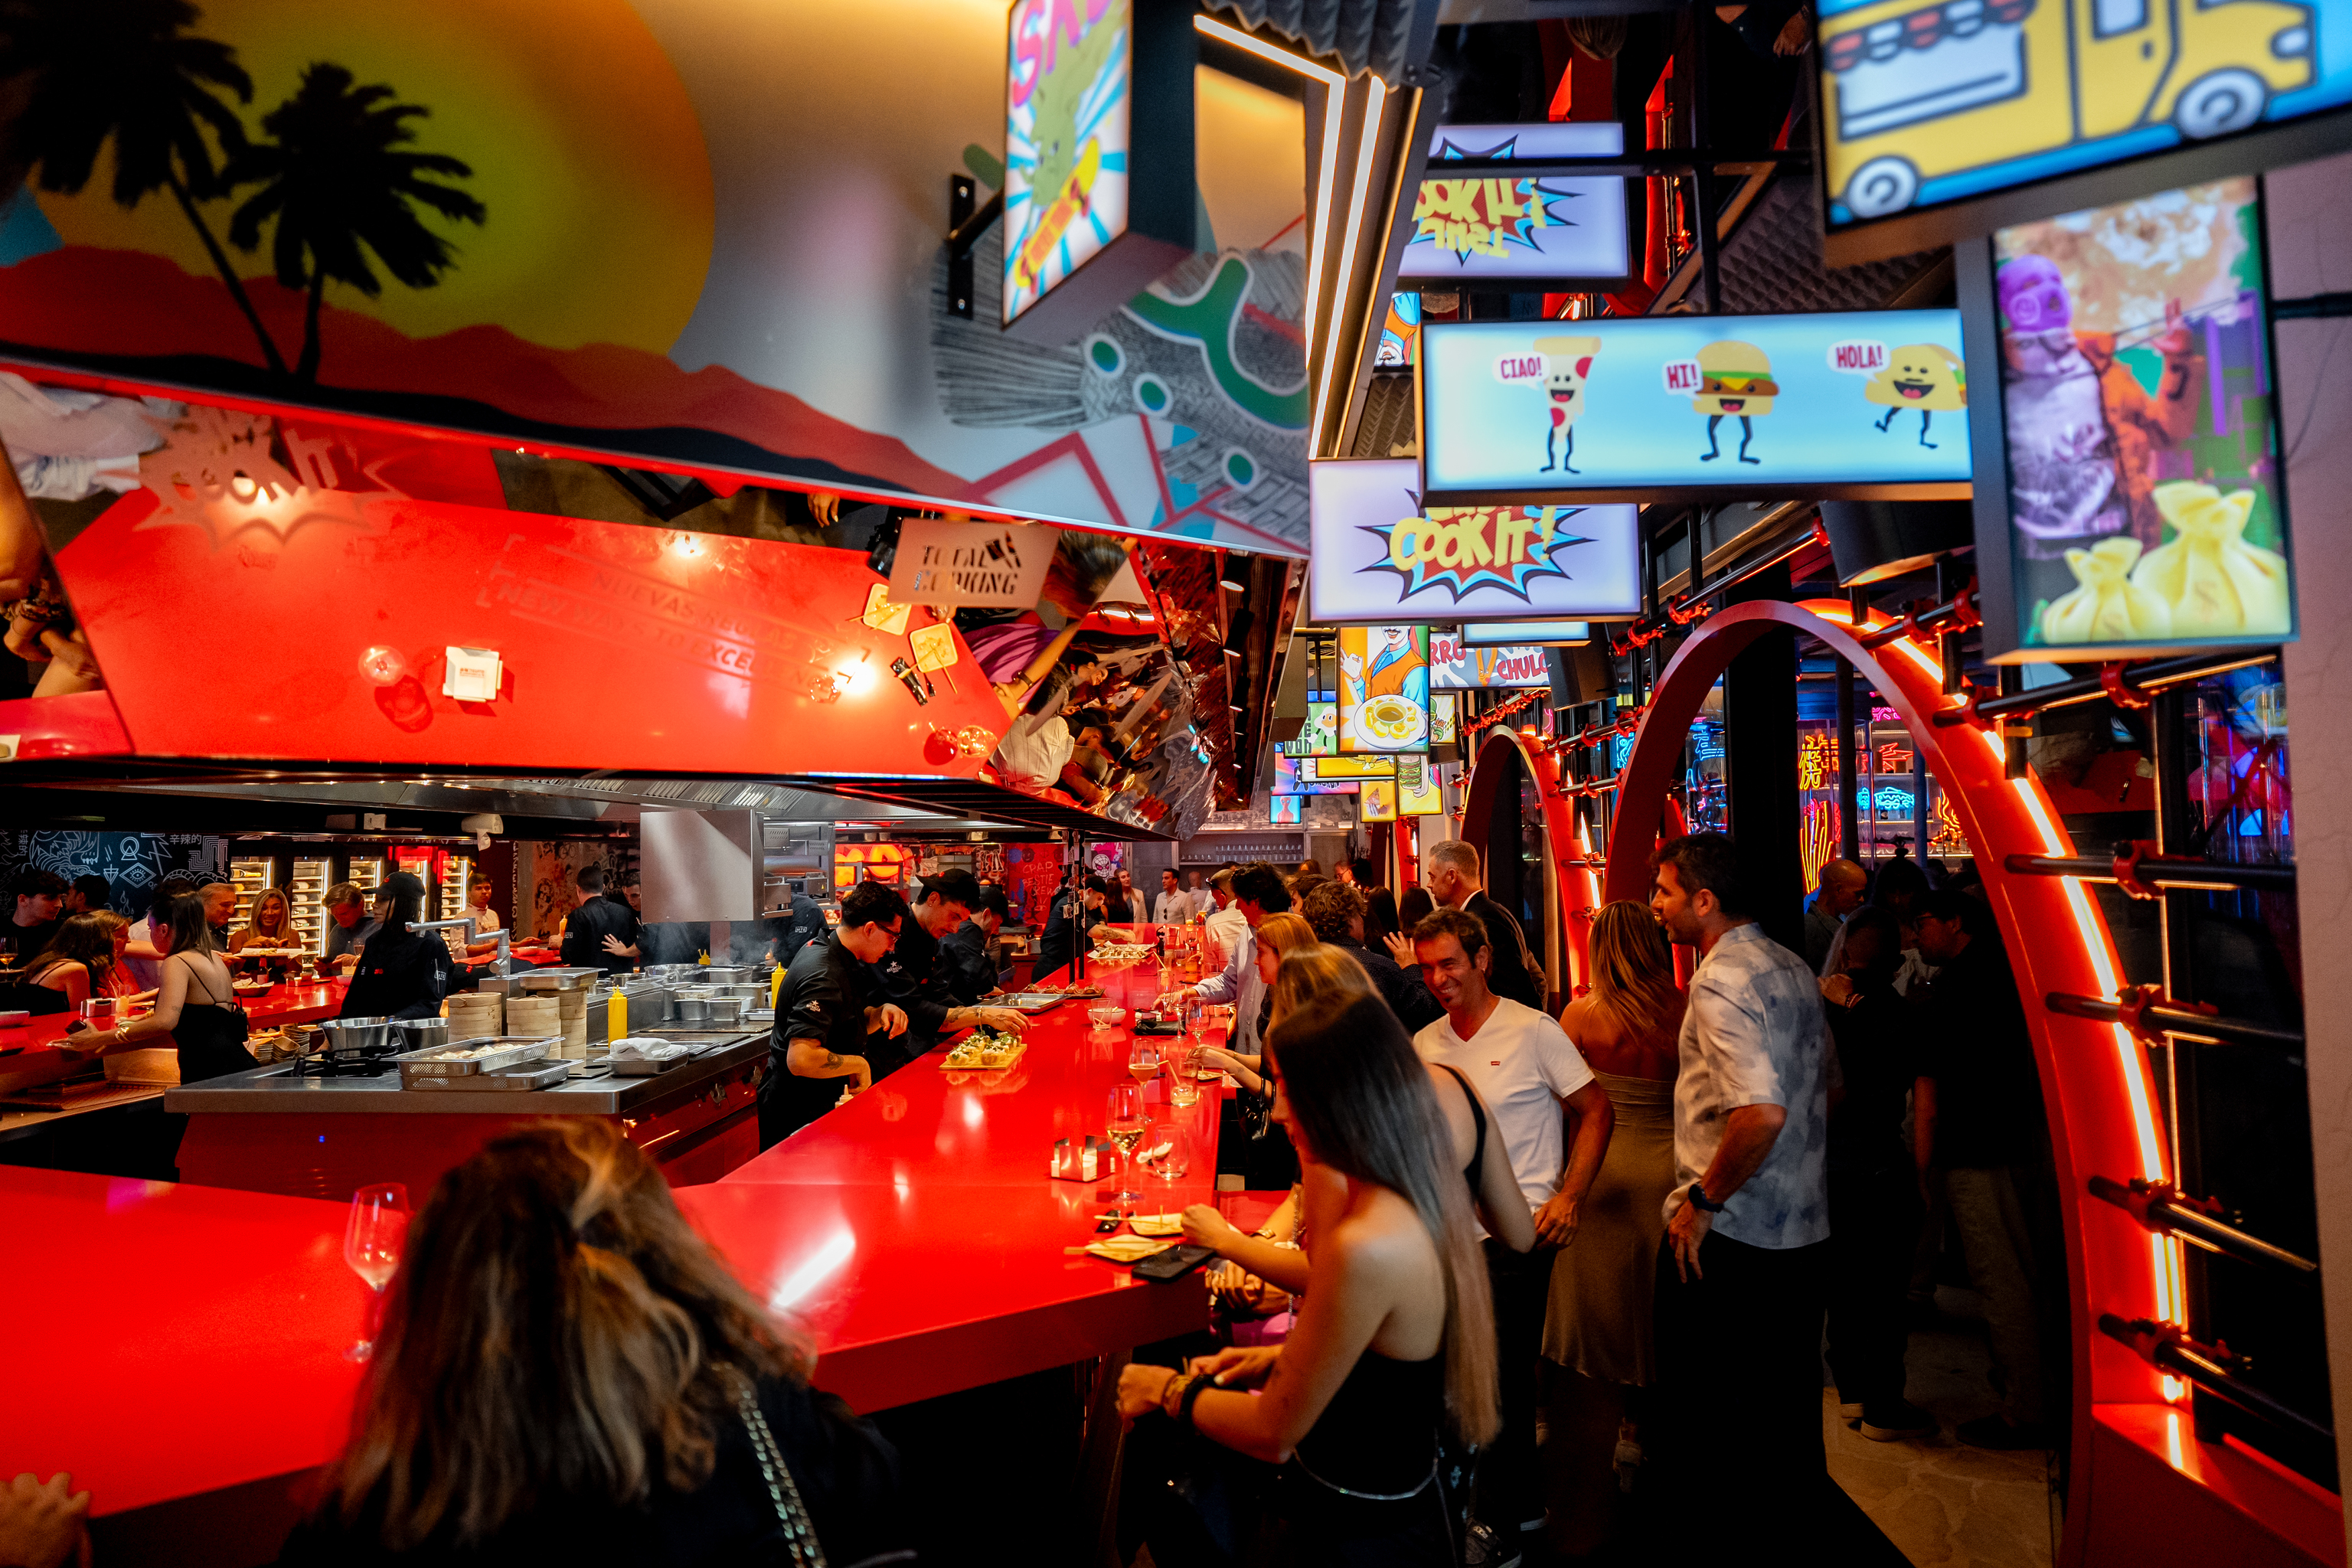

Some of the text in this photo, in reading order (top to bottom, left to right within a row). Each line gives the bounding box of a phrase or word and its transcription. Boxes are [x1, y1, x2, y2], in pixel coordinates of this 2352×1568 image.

[1501, 356, 1543, 380] CIAO!
[1835, 345, 1884, 369] HOLA!
[1666, 364, 1698, 389] HI!
[1389, 512, 1494, 571] COOK
[496, 580, 568, 615] NEW
[592, 572, 694, 617] NUEVAS
[169, 834, 202, 845] 辛辣的
